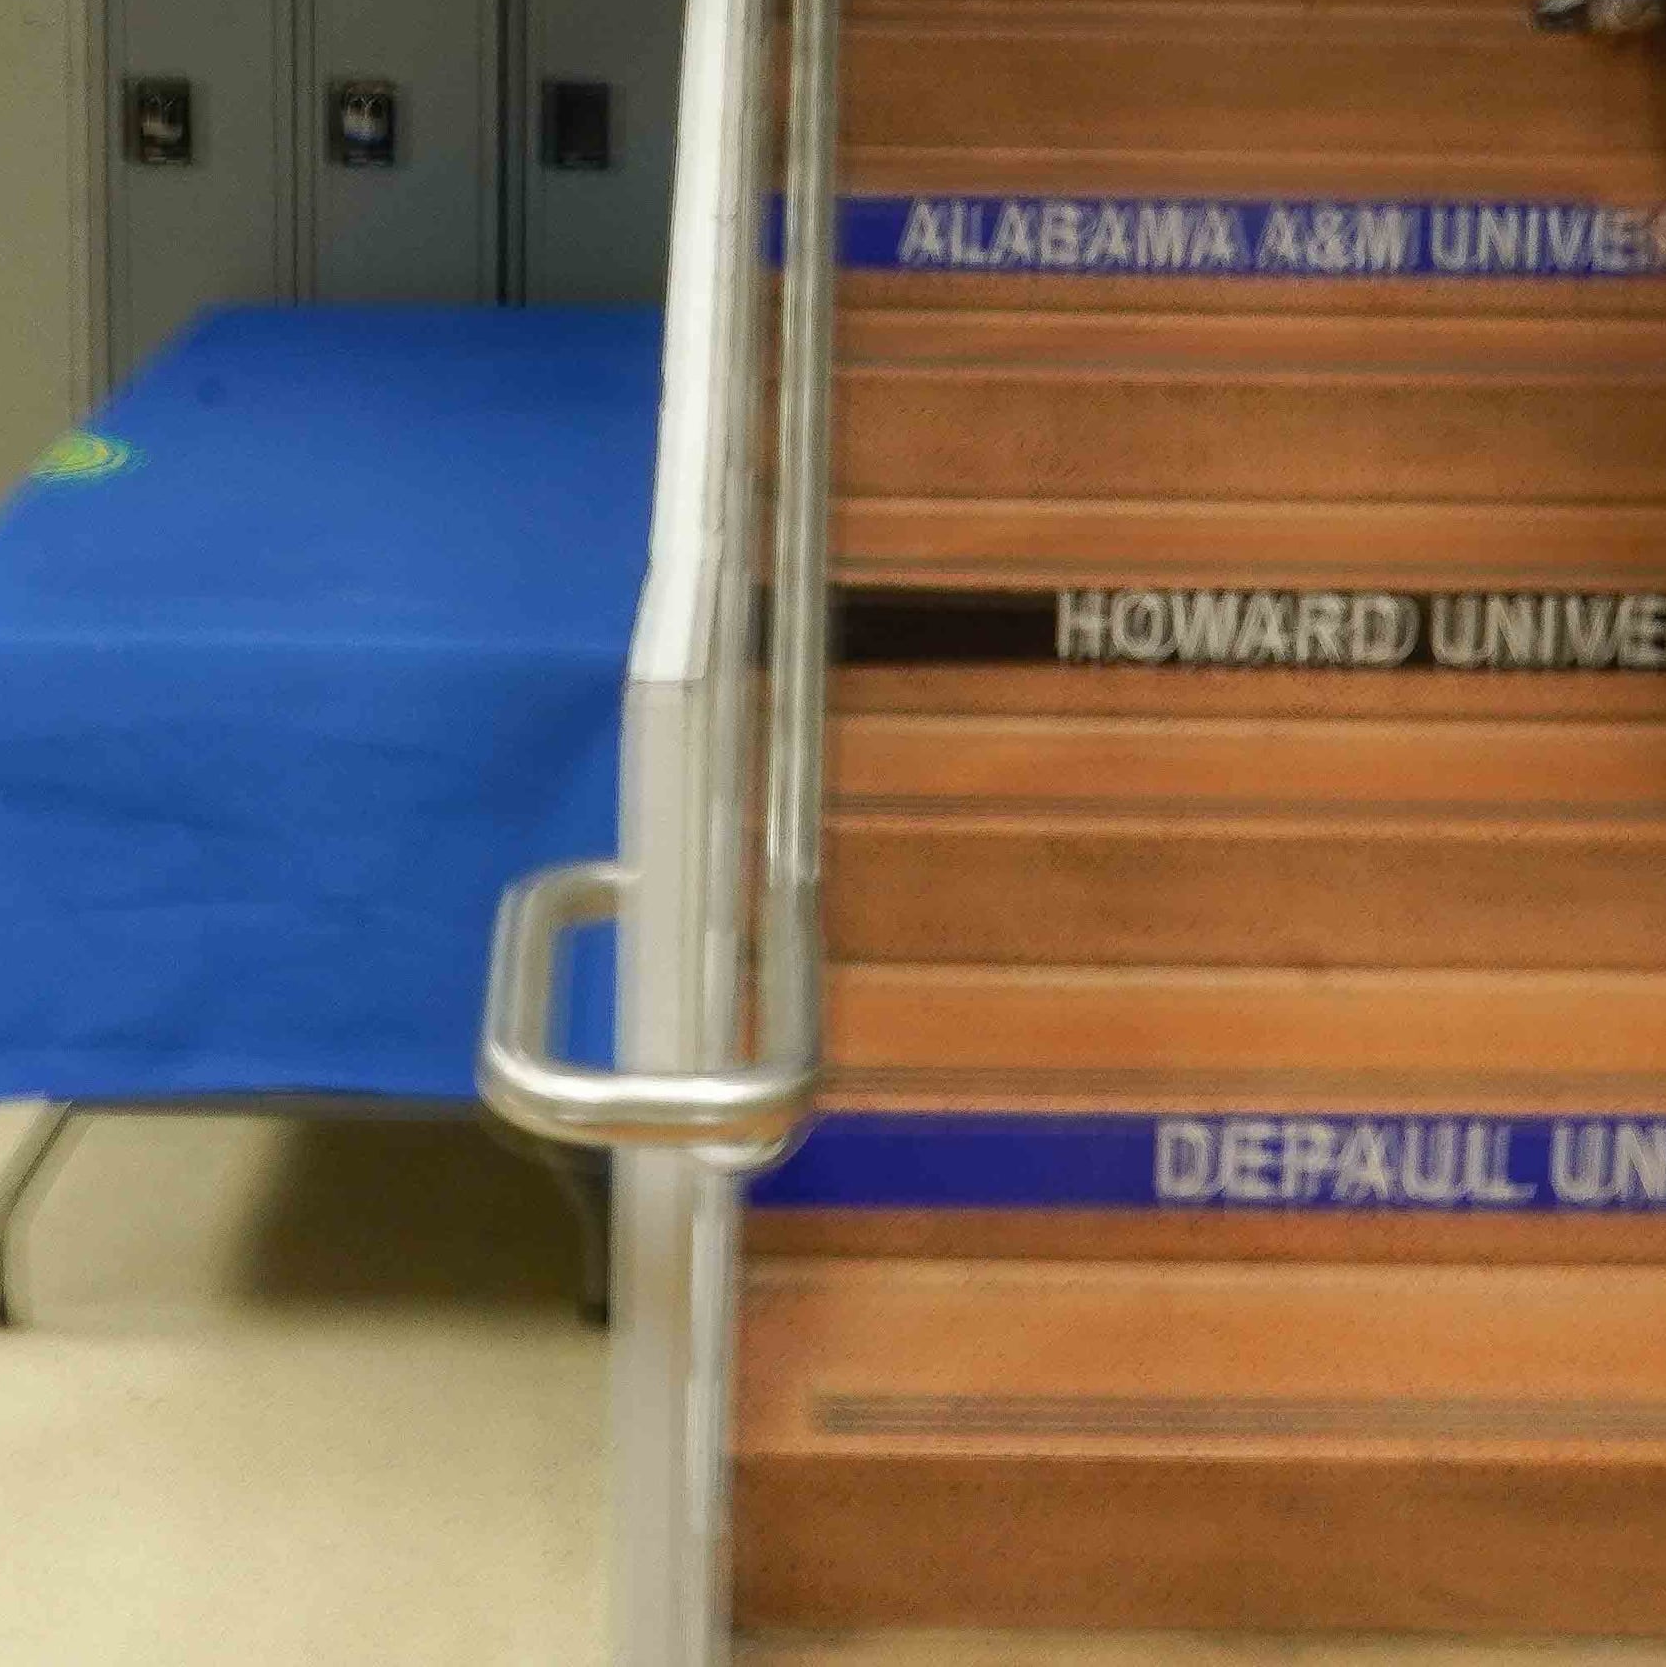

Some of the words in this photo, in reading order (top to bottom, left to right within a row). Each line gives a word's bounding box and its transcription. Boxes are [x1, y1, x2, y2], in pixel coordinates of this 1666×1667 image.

[897, 198, 1238, 270] ALABAMA
[1255, 201, 1408, 274] A&M
[1053, 590, 1417, 667] HOWARD
[1153, 1121, 1537, 1202] DEPAUL
